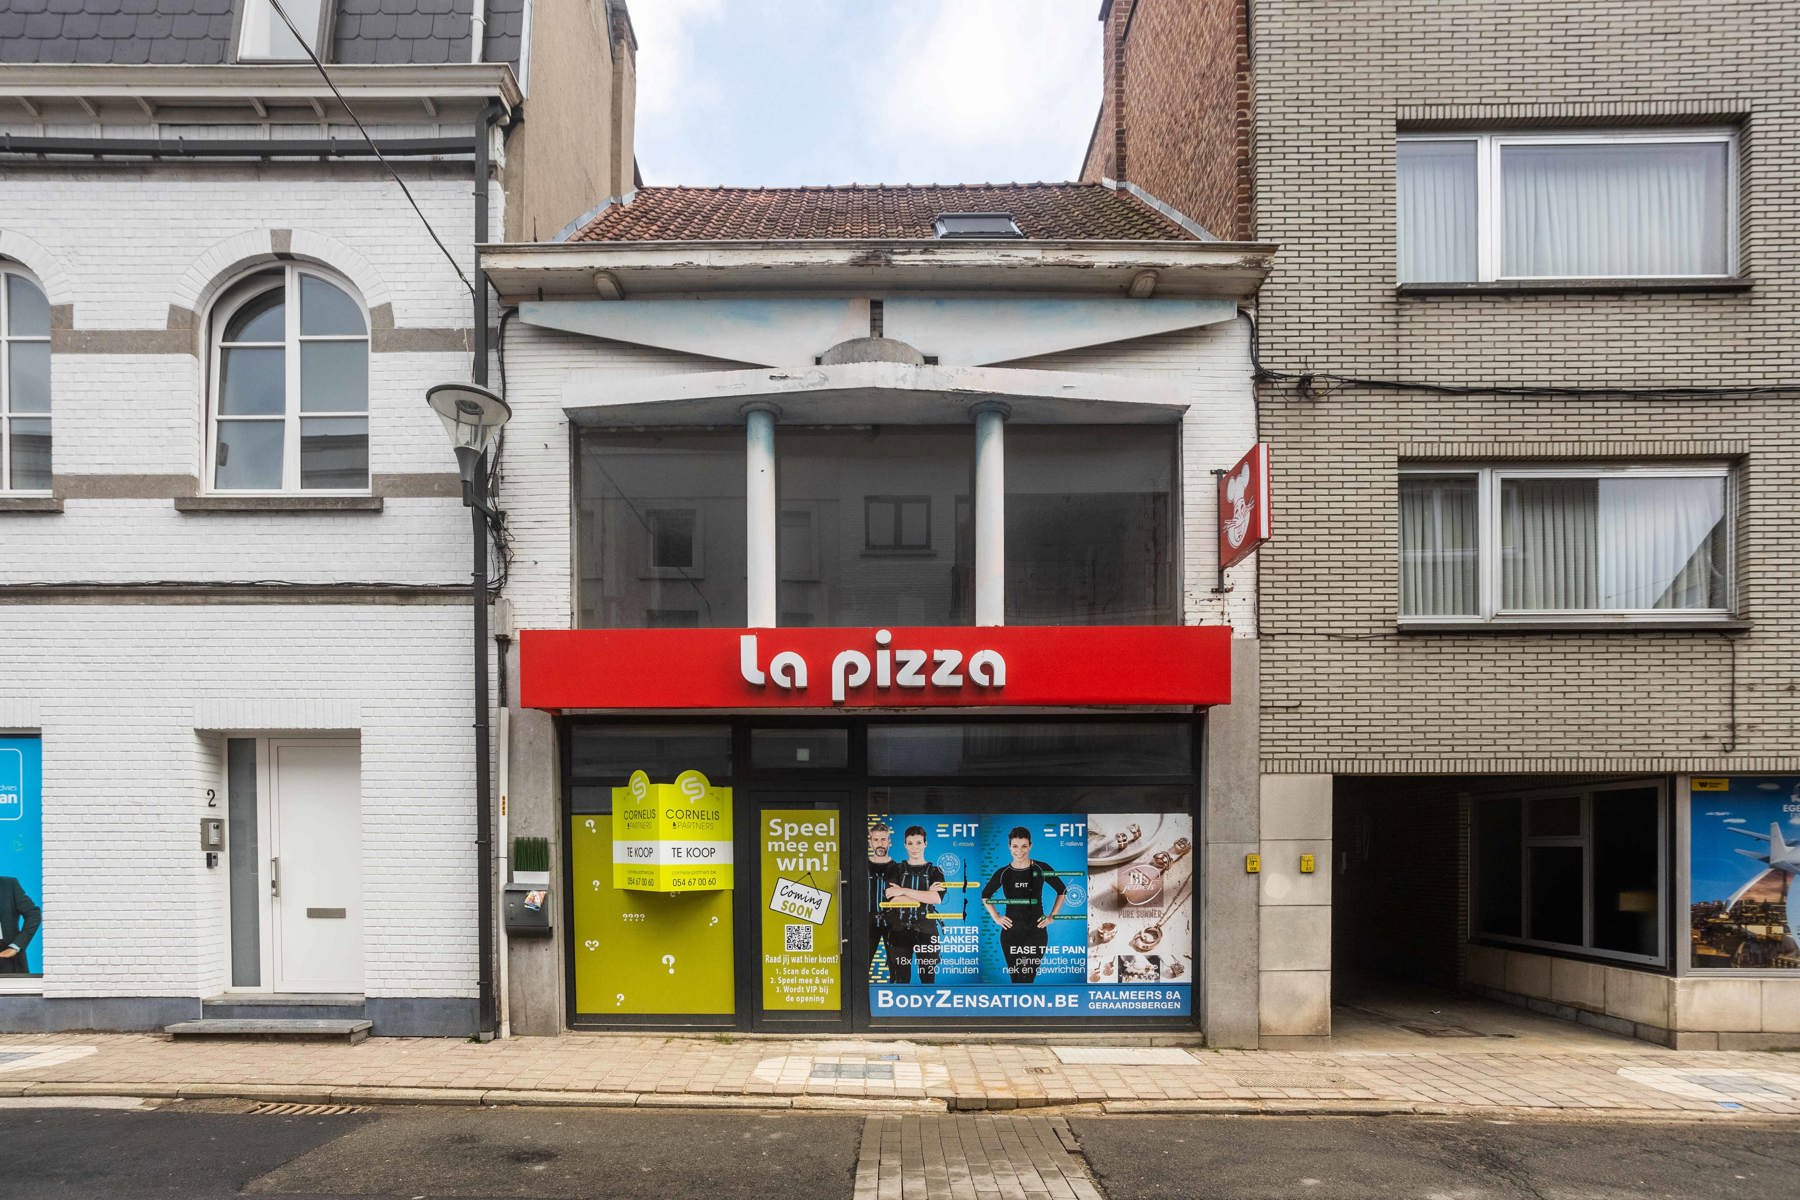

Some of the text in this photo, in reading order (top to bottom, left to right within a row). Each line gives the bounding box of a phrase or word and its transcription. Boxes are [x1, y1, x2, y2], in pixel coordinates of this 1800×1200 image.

[740, 629, 1006, 703] La pizza
[206, 789, 217, 808] 2
[623, 809, 656, 820] CORNELIS
[665, 809, 720, 821] CORNELIS
[769, 818, 835, 840] Speel
[768, 841, 837, 852] mee en
[627, 847, 654, 858] TE KOOP
[671, 847, 716, 858] TE KOOP
[776, 853, 829, 872] win!
[672, 877, 717, 887] 054 67 00 60
[780, 885, 822, 910] Coming
[781, 900, 813, 919] SOON
[1118, 909, 1134, 918] PURE
[943, 926, 979, 935] FITTER
[930, 935, 979, 944] SLANKER
[913, 944, 979, 953] GESPIERDER
[1009, 946, 1086, 955] EASE THE PAIN
[765, 954, 782, 963] Raad
[791, 955, 803, 963] wat
[804, 954, 817, 963] hier
[818, 954, 839, 963] komt?
[896, 957, 912, 965] 18x
[940, 957, 979, 965] resultaat
[1015, 957, 1086, 966] pijnreductie rug
[918, 966, 979, 975] in 20 minuten
[1002, 966, 1020, 974] nek
[1035, 965, 1086, 975] gewrichten
[778, 976, 797, 985] Speel
[819, 985, 829, 994] bij
[795, 996, 825, 1004] opening
[1088, 990, 1181, 1000] TAALMEERS 8A
[1088, 1001, 1181, 1010] GERAARDSBERGEN
